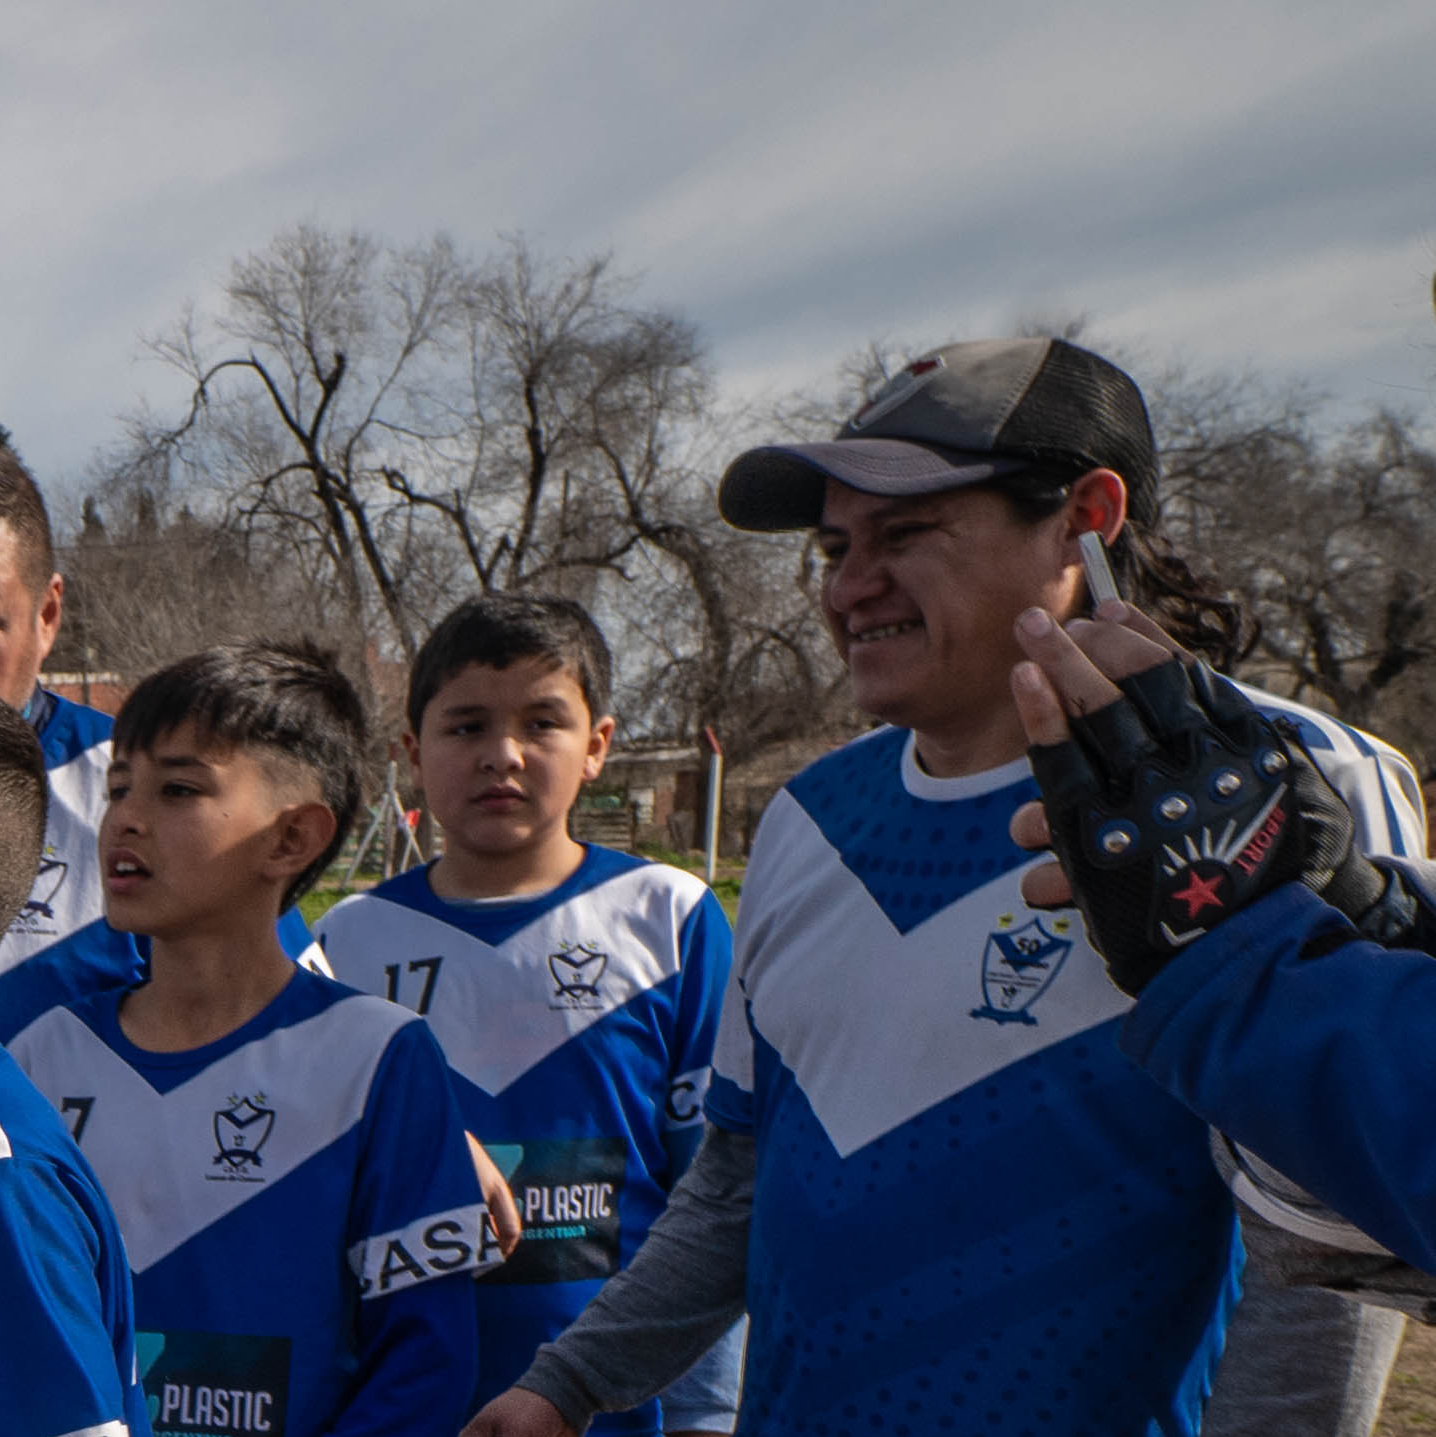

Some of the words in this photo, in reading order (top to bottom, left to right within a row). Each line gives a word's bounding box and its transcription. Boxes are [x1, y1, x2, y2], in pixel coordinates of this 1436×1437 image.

[384, 956, 444, 1015] 17
[526, 1183, 613, 1223] PLASTIC
[161, 1383, 273, 1432] PLASTIC
